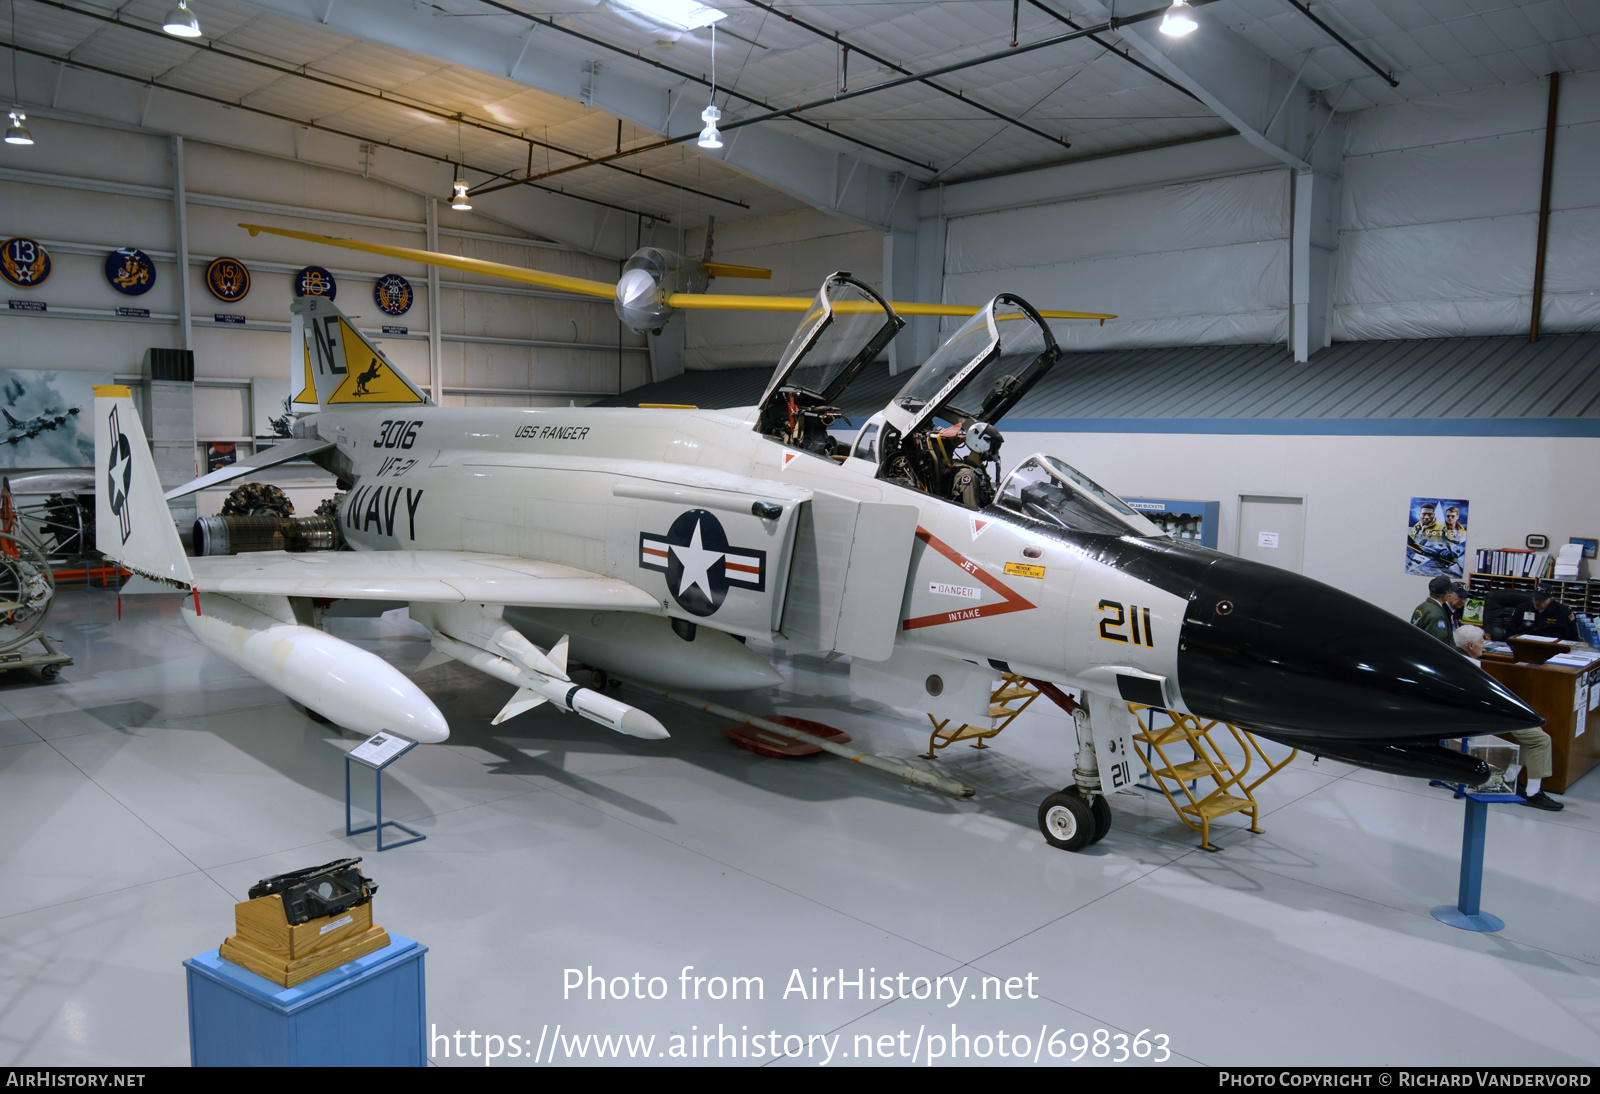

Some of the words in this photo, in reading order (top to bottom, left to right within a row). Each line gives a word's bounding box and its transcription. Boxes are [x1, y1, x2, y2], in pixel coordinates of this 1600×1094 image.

[14, 240, 35, 263] 13
[223, 265, 235, 278] 15
[306, 271, 323, 295] 18
[389, 285, 399, 294] 20
[312, 315, 347, 375] NE
[373, 420, 424, 450] 3016
[515, 425, 537, 439] USS
[538, 426, 591, 440] RANGER
[347, 485, 424, 541] NAVY
[960, 560, 979, 574] JET
[938, 584, 974, 597] DANGER
[948, 608, 981, 621] INTAKE
[1097, 599, 1154, 648] 211
[1110, 760, 1131, 788] 211
